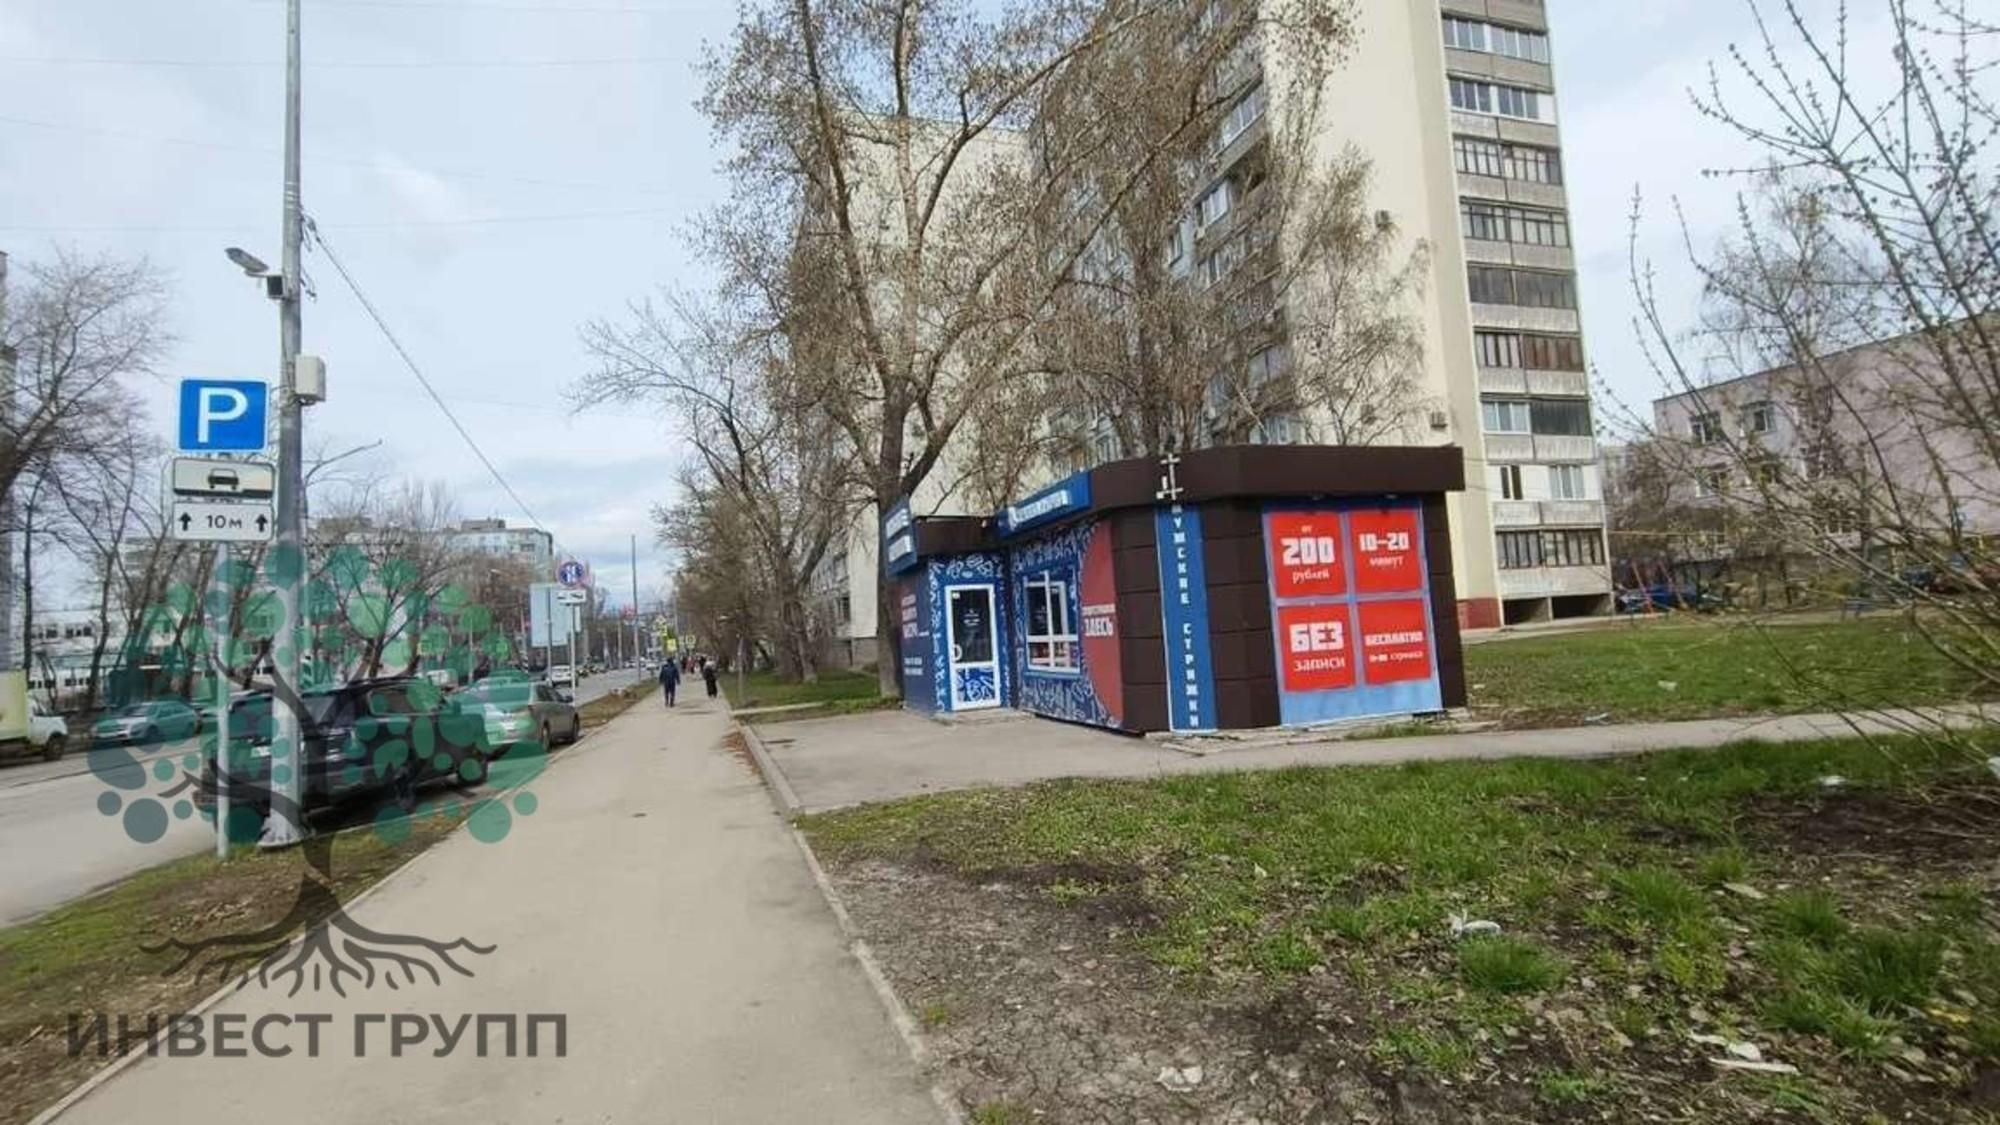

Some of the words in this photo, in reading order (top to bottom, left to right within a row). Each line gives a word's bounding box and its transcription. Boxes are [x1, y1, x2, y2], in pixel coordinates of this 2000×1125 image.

[197, 387, 248, 443] P
[207, 515, 227, 529] 10
[1281, 537, 1335, 566] 200
[1359, 532, 1410, 551] 10-20
[1292, 568, 1330, 584] рублей
[1084, 616, 1114, 637] ЗДЕСЬ
[1289, 621, 1344, 653] БЕЗ
[1182, 623, 1199, 727] СТРИЖКИ
[1294, 657, 1346, 673] записи
